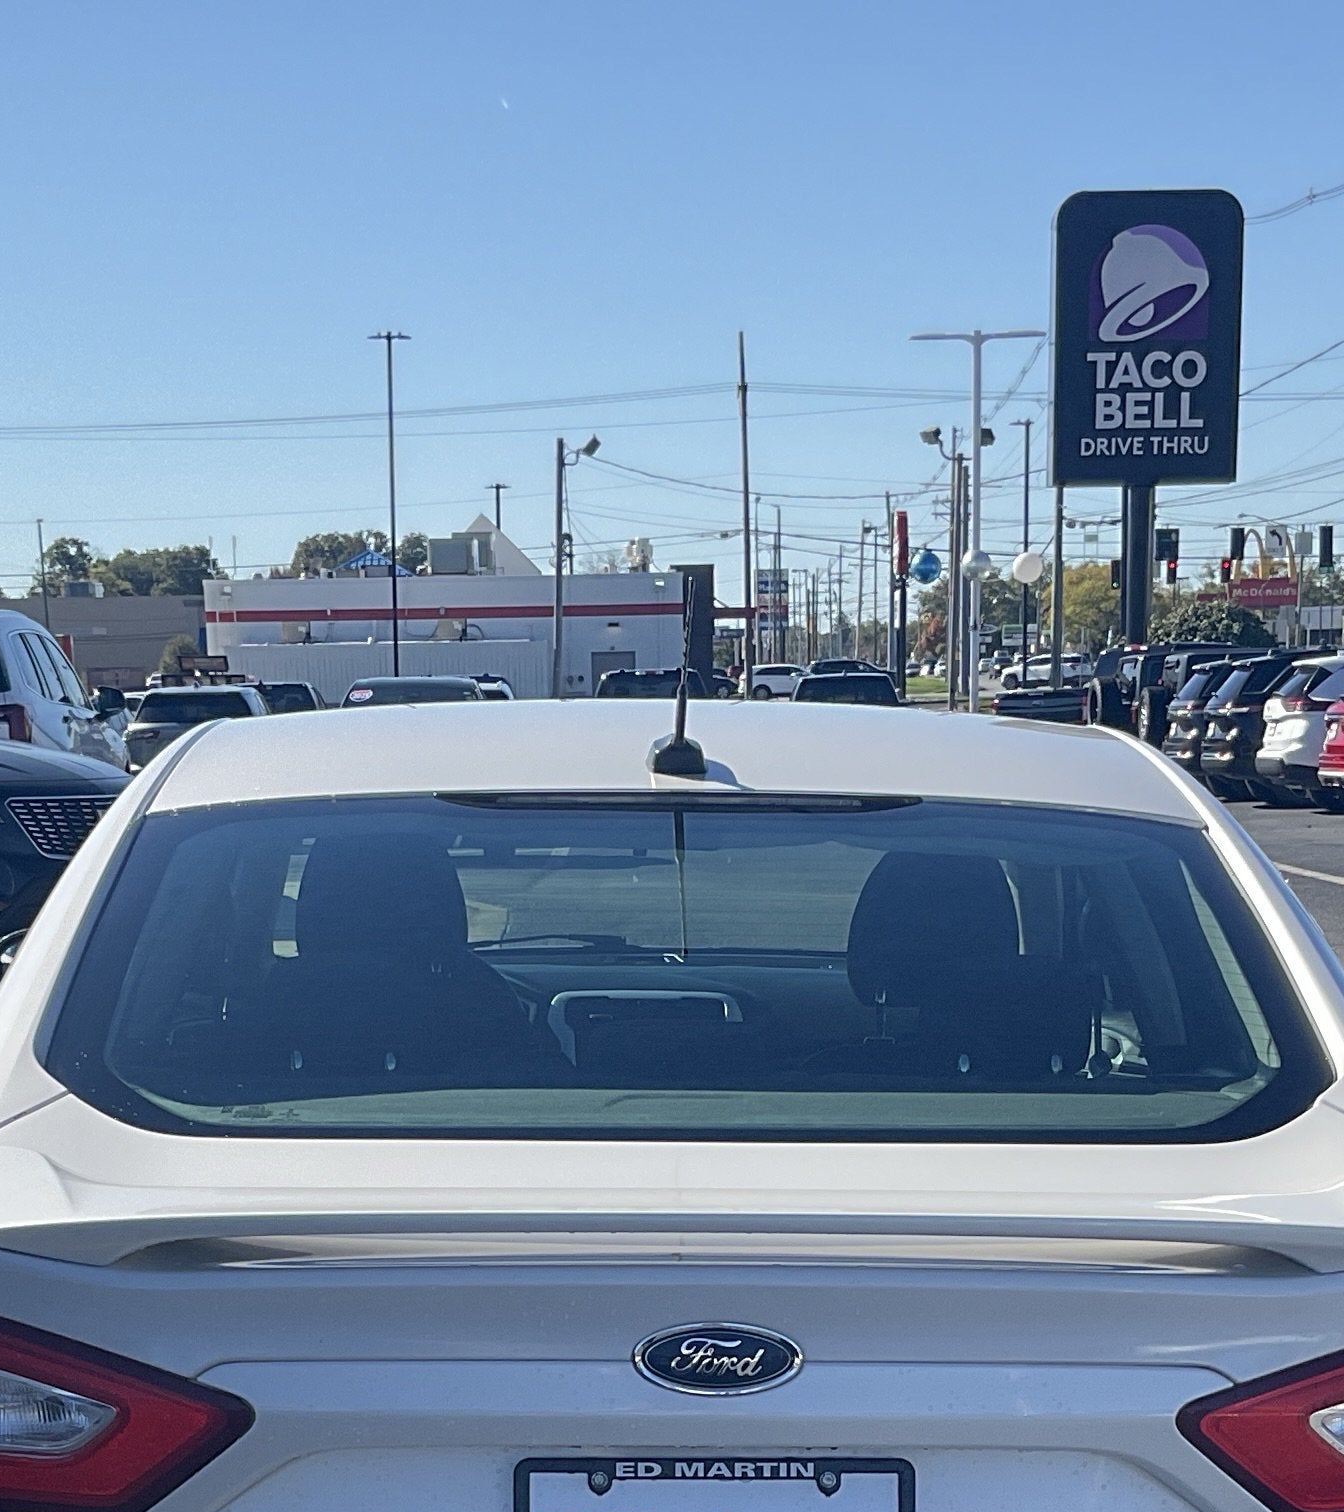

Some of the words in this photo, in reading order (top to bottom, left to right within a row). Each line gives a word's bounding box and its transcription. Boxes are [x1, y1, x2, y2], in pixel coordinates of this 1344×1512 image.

[1086, 350, 1207, 389] TACO
[1094, 391, 1205, 430] BELL
[1079, 437, 1145, 457] DRIVE
[1149, 436, 1209, 455] THRU
[1231, 586, 1297, 598] McDonald's
[670, 1337, 765, 1377] Ford
[615, 1461, 661, 1478] ED
[674, 1461, 816, 1478] MARTIN
